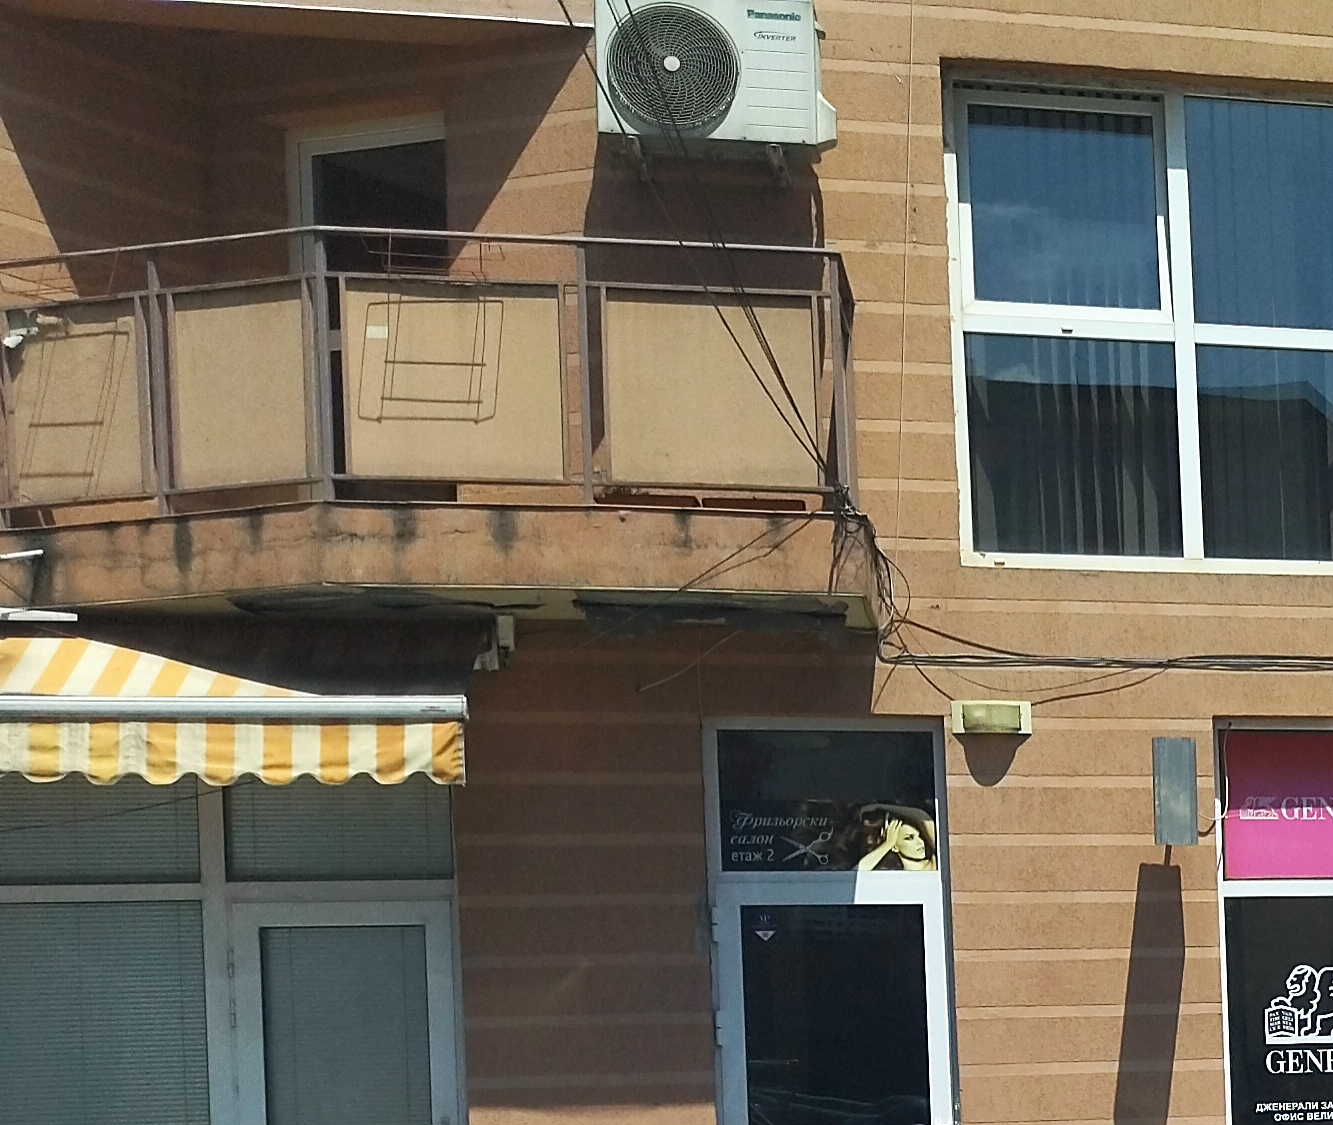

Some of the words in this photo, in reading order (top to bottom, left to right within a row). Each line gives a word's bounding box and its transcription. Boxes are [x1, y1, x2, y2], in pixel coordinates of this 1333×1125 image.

[747, 9, 801, 21] Panasonic
[756, 33, 796, 42] INVERTER
[729, 810, 828, 831] Фризьорски
[730, 834, 775, 845] салон
[731, 850, 763, 862] етаж
[766, 848, 775, 862] 2
[1255, 1101, 1319, 1113] ДЖЕНЕРАЛИ
[1273, 1112, 1305, 1122] ОФИС
